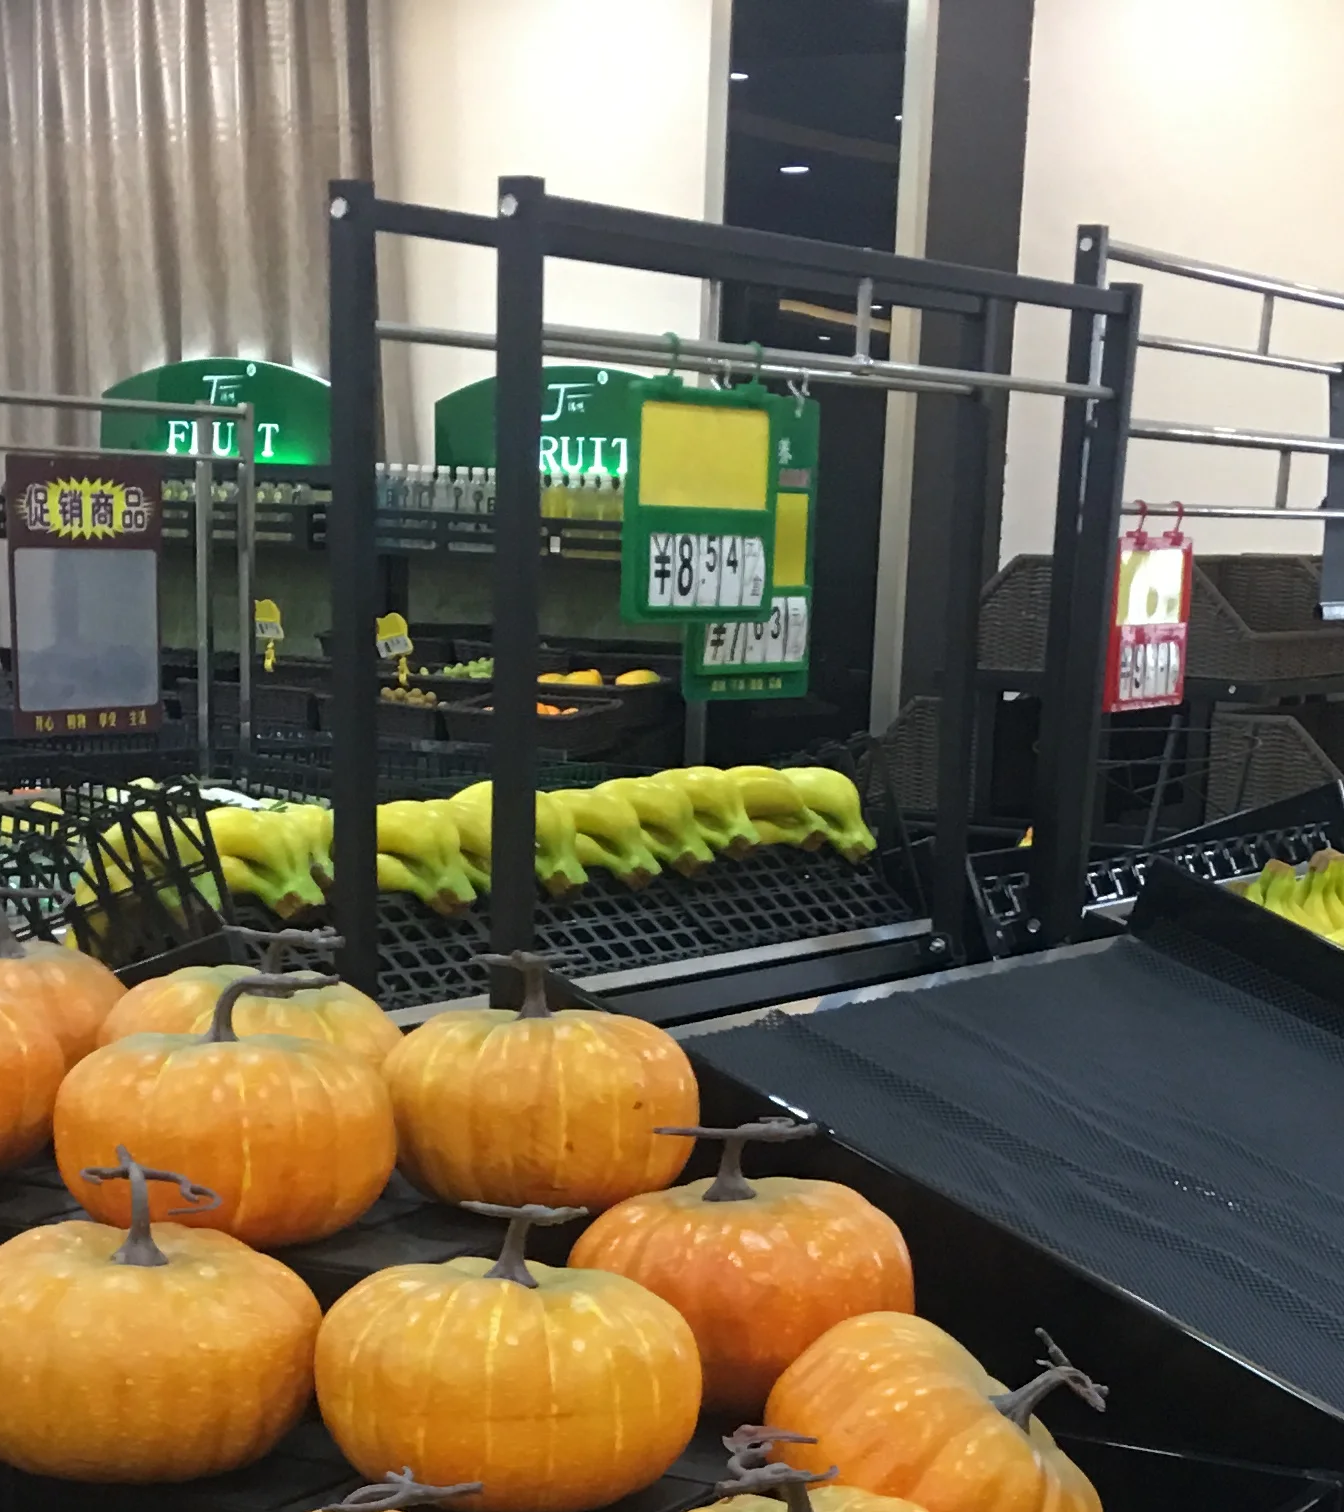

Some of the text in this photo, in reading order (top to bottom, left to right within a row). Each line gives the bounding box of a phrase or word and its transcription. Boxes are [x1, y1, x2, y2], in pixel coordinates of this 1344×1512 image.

[166, 420, 280, 458] FUT
[25, 484, 147, 532] 促销商品
